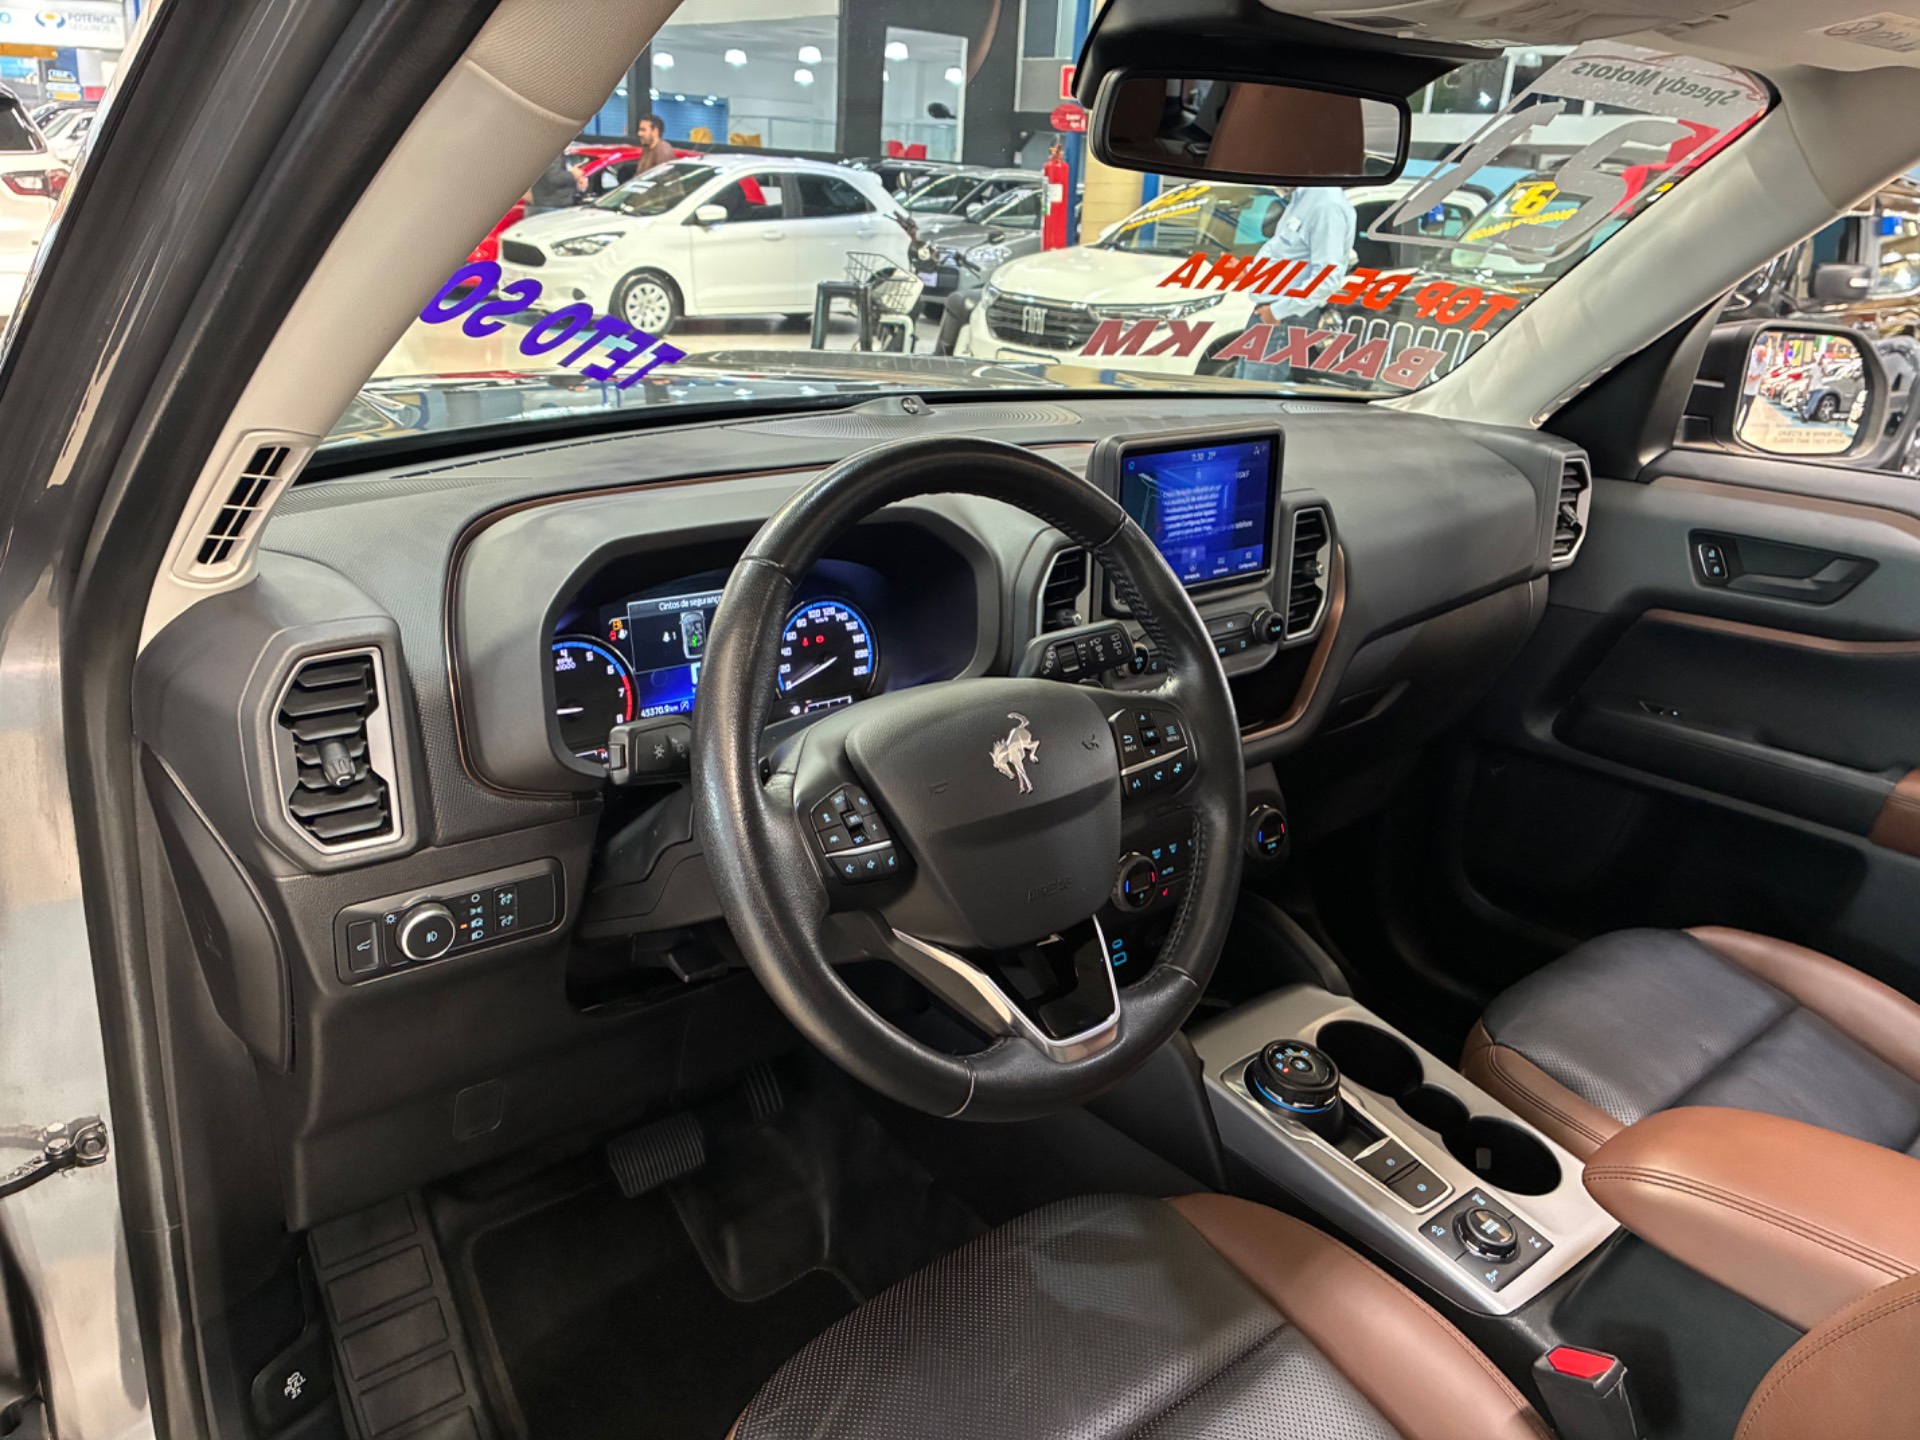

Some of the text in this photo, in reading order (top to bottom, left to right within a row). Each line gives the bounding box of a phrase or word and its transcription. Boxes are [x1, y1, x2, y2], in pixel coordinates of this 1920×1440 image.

[1022, 305, 1048, 335] FIAT
[659, 601, 680, 612] Cintos
[681, 599, 689, 607] de
[823, 607, 835, 616] 120
[836, 612, 848, 621] 140
[560, 649, 568, 657] 4
[618, 688, 625, 698] 7
